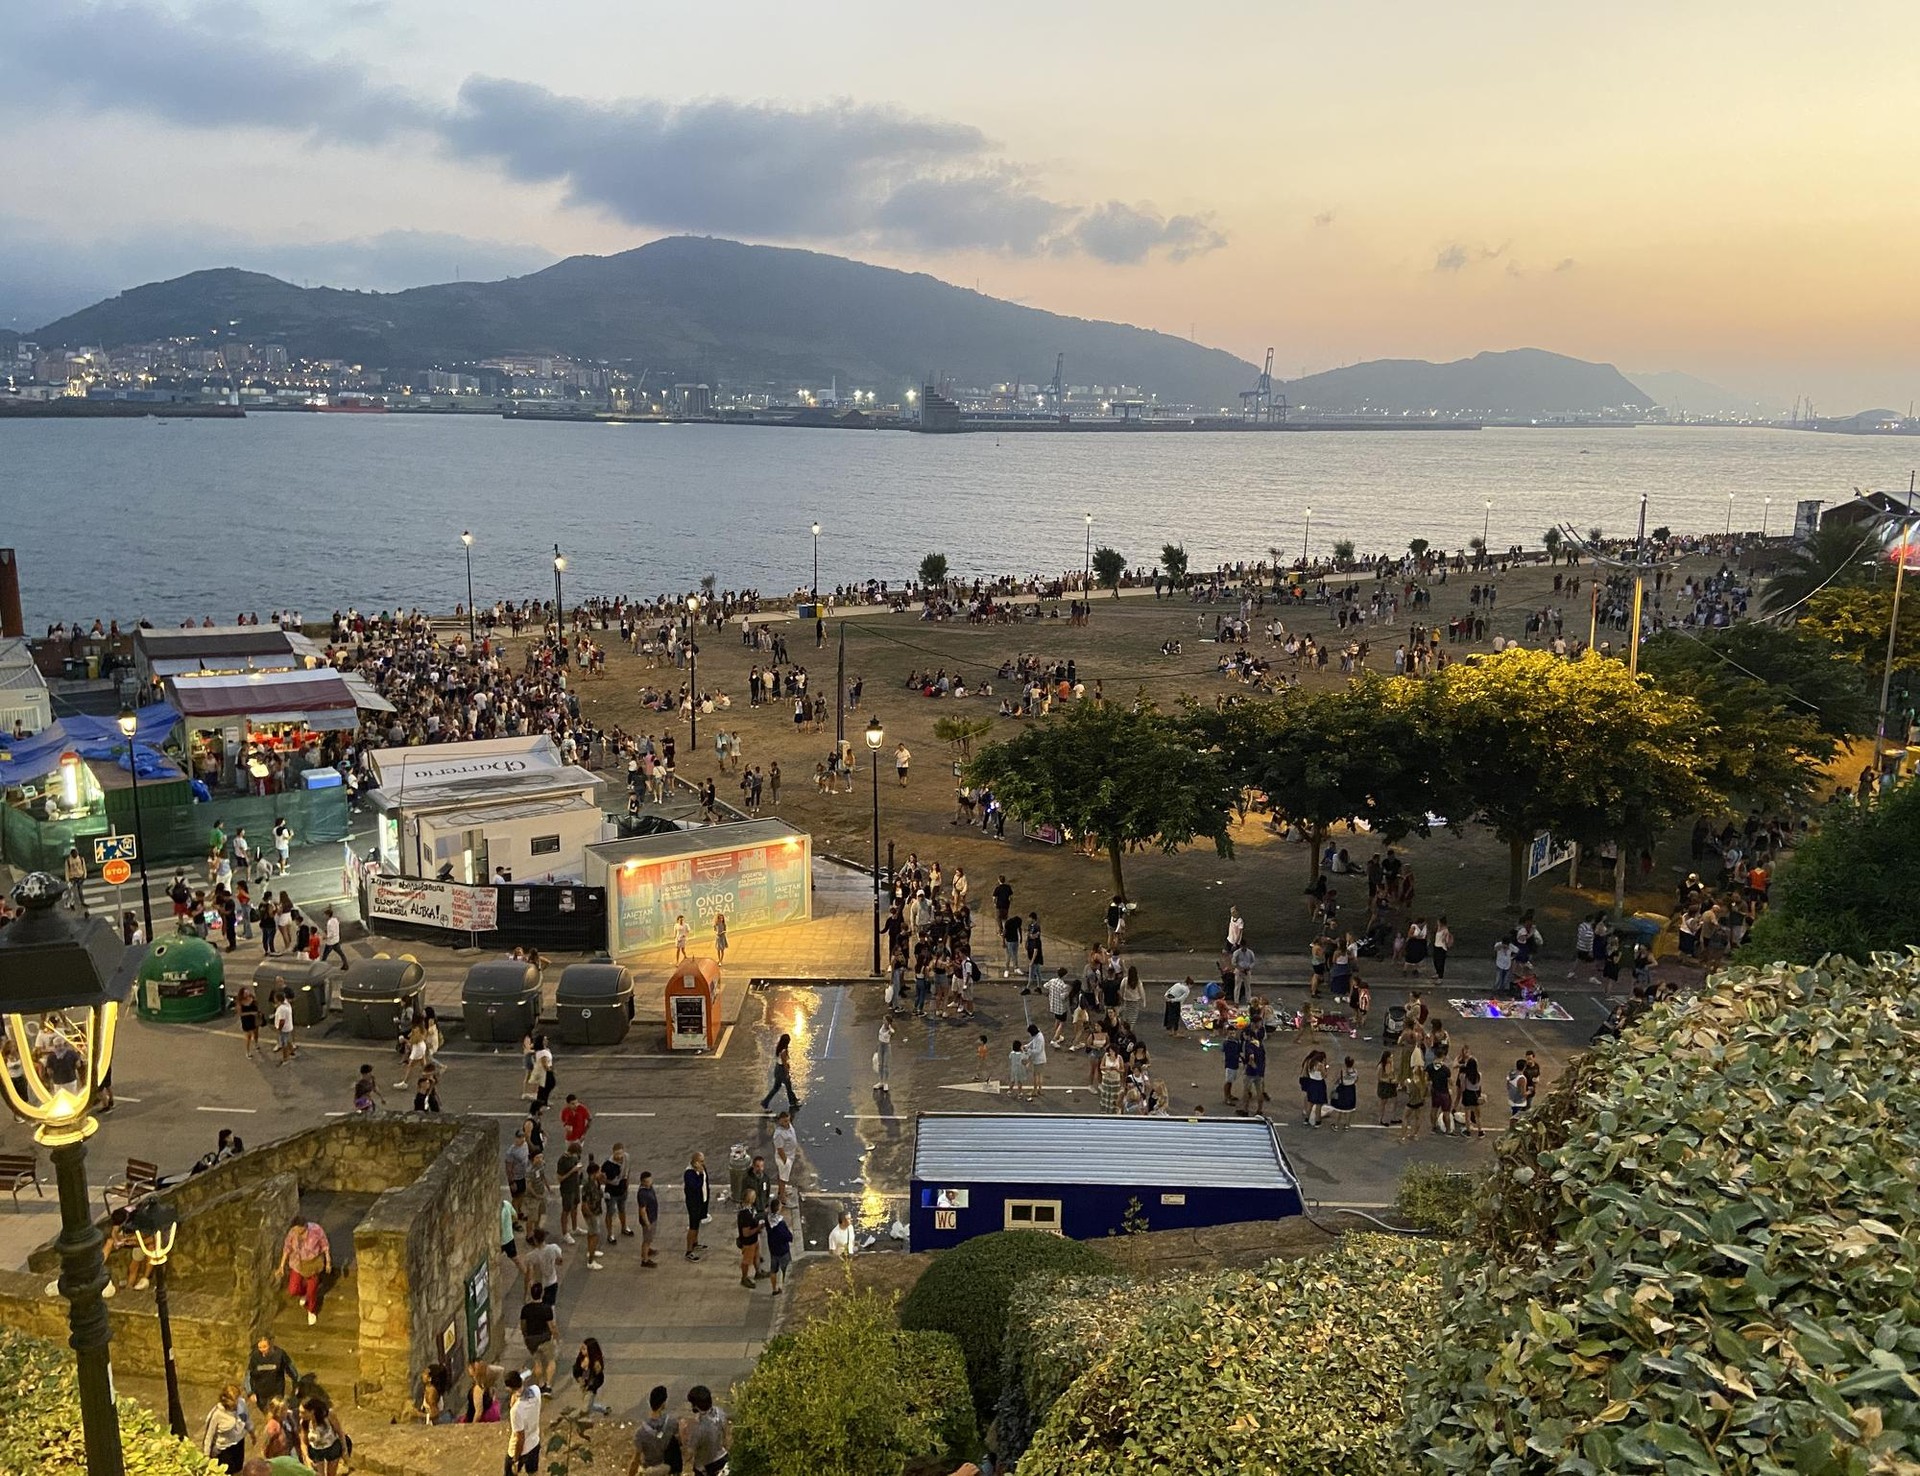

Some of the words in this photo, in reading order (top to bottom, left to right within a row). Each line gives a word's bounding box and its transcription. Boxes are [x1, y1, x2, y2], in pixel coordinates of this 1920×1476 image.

[105, 866, 128, 876] STOP
[696, 892, 734, 908] ONDO
[699, 903, 735, 918] PASA!
[937, 1211, 956, 1228] WC
